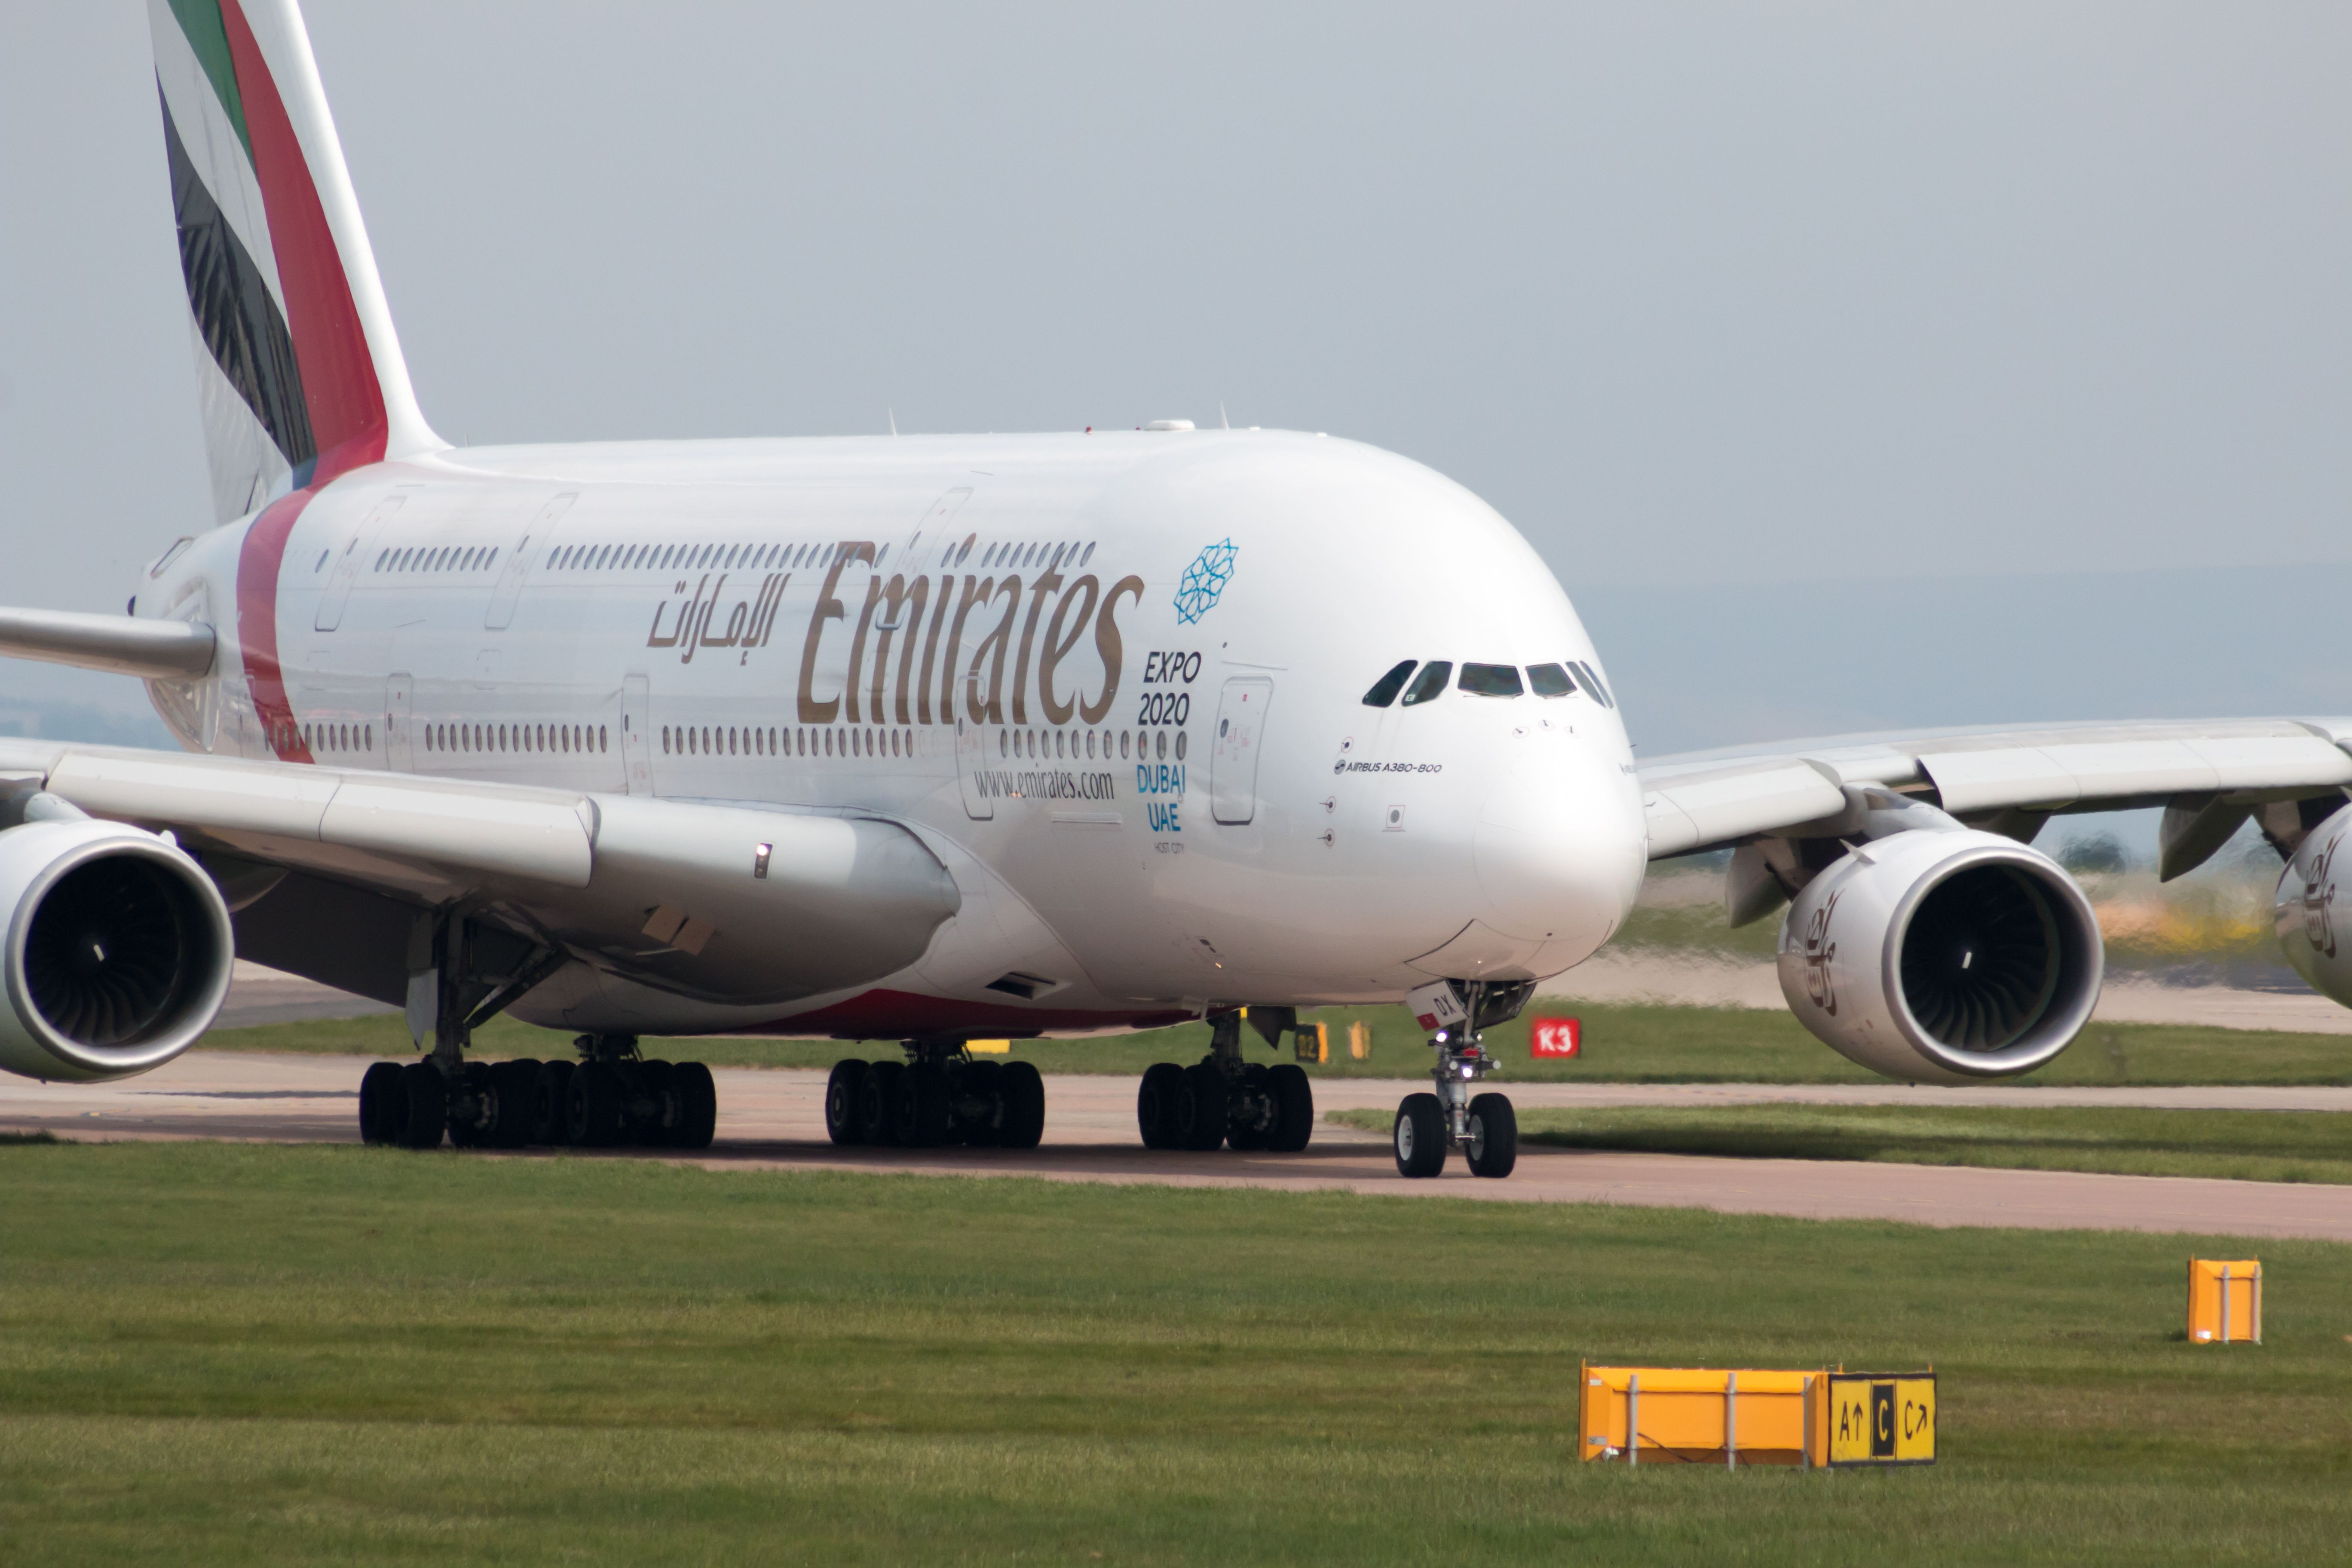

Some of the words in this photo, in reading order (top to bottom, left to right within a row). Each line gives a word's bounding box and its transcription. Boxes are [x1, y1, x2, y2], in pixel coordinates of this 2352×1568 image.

[646, 573, 792, 666] الإمارات
[797, 532, 1145, 725] Emirates
[1143, 651, 1201, 683] EXPO
[1138, 692, 1190, 726] 2020
[974, 763, 1115, 799] www.emirates.com
[1136, 764, 1185, 793] DUBAI
[1345, 762, 1381, 772] AIRBUS
[1382, 763, 1442, 773] A380-800
[1147, 802, 1181, 832] UAE
[1154, 842, 1169, 853] HOST
[1171, 842, 1184, 854] CITY
[1537, 1026, 1571, 1052] K3
[1839, 1401, 1850, 1442] A
[1878, 1399, 1888, 1442] C
[1905, 1400, 1913, 1440] C
